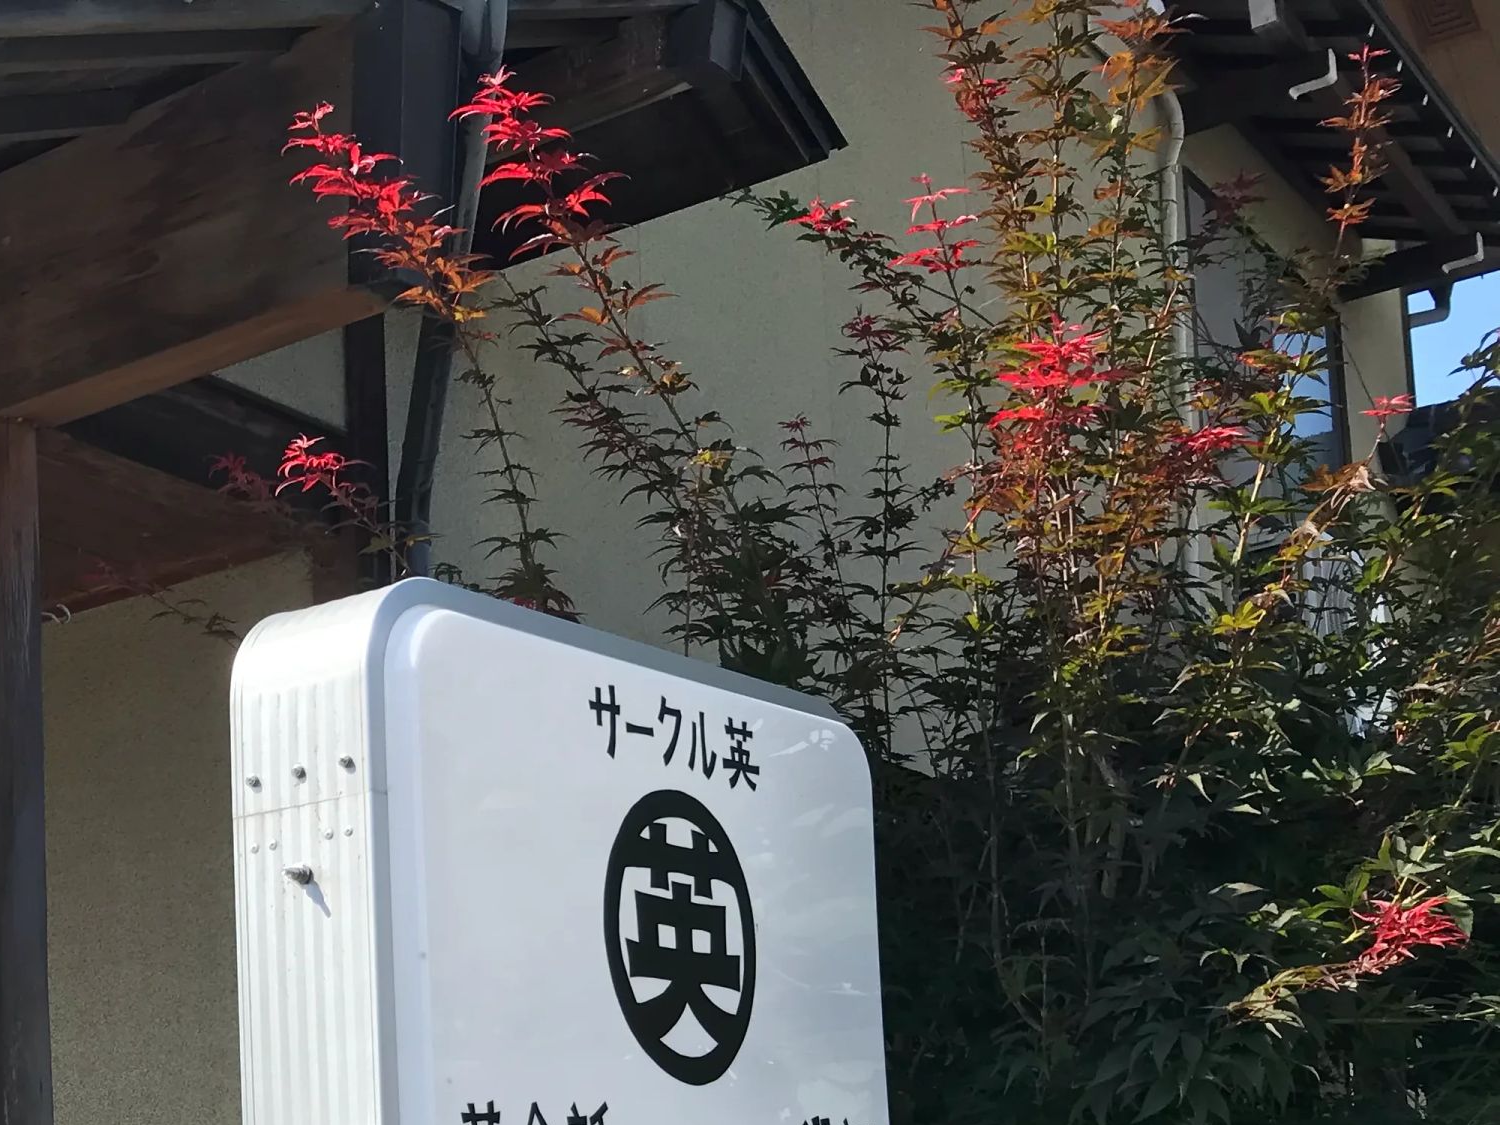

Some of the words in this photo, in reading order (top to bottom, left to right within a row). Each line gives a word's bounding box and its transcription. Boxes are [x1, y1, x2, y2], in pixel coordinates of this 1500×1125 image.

[588, 684, 761, 793] サークル英
[611, 812, 750, 1064] 英
